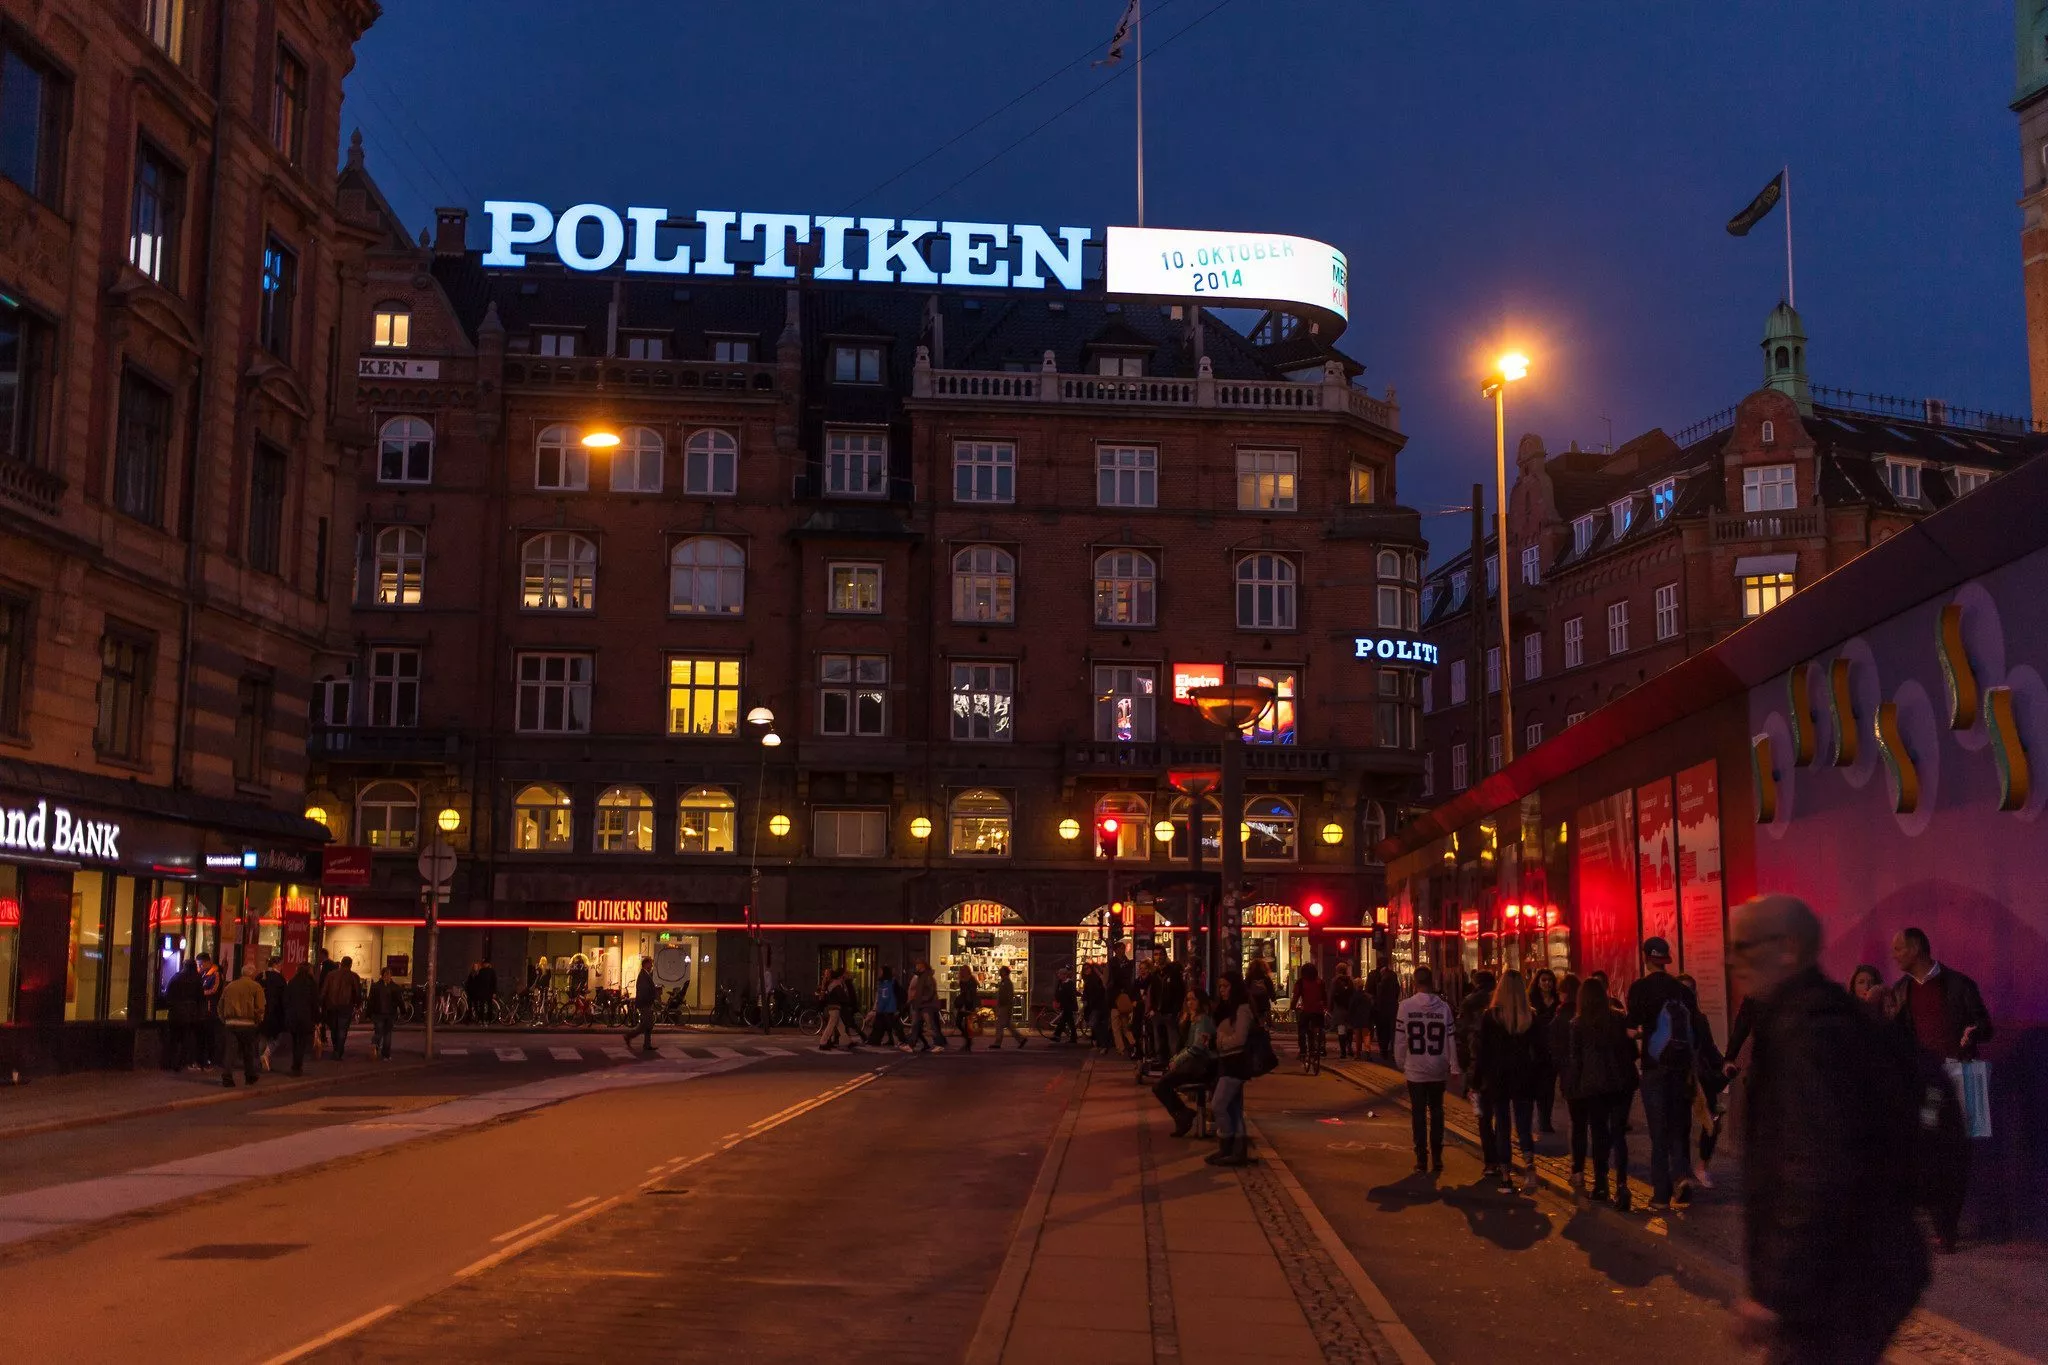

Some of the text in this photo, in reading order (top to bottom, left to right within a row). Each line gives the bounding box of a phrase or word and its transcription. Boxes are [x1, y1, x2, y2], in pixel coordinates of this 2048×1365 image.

[481, 200, 1091, 290] POLITIKEN
[1192, 268, 1243, 292] 2014
[360, 360, 408, 375] KEN
[1355, 638, 1438, 664] POLITI
[52, 806, 121, 860] BANK
[577, 900, 668, 921] POLITIKENS HUS
[962, 904, 1002, 924] BØGER
[1255, 905, 1292, 926] BØGER
[1407, 1021, 1446, 1055] 89
